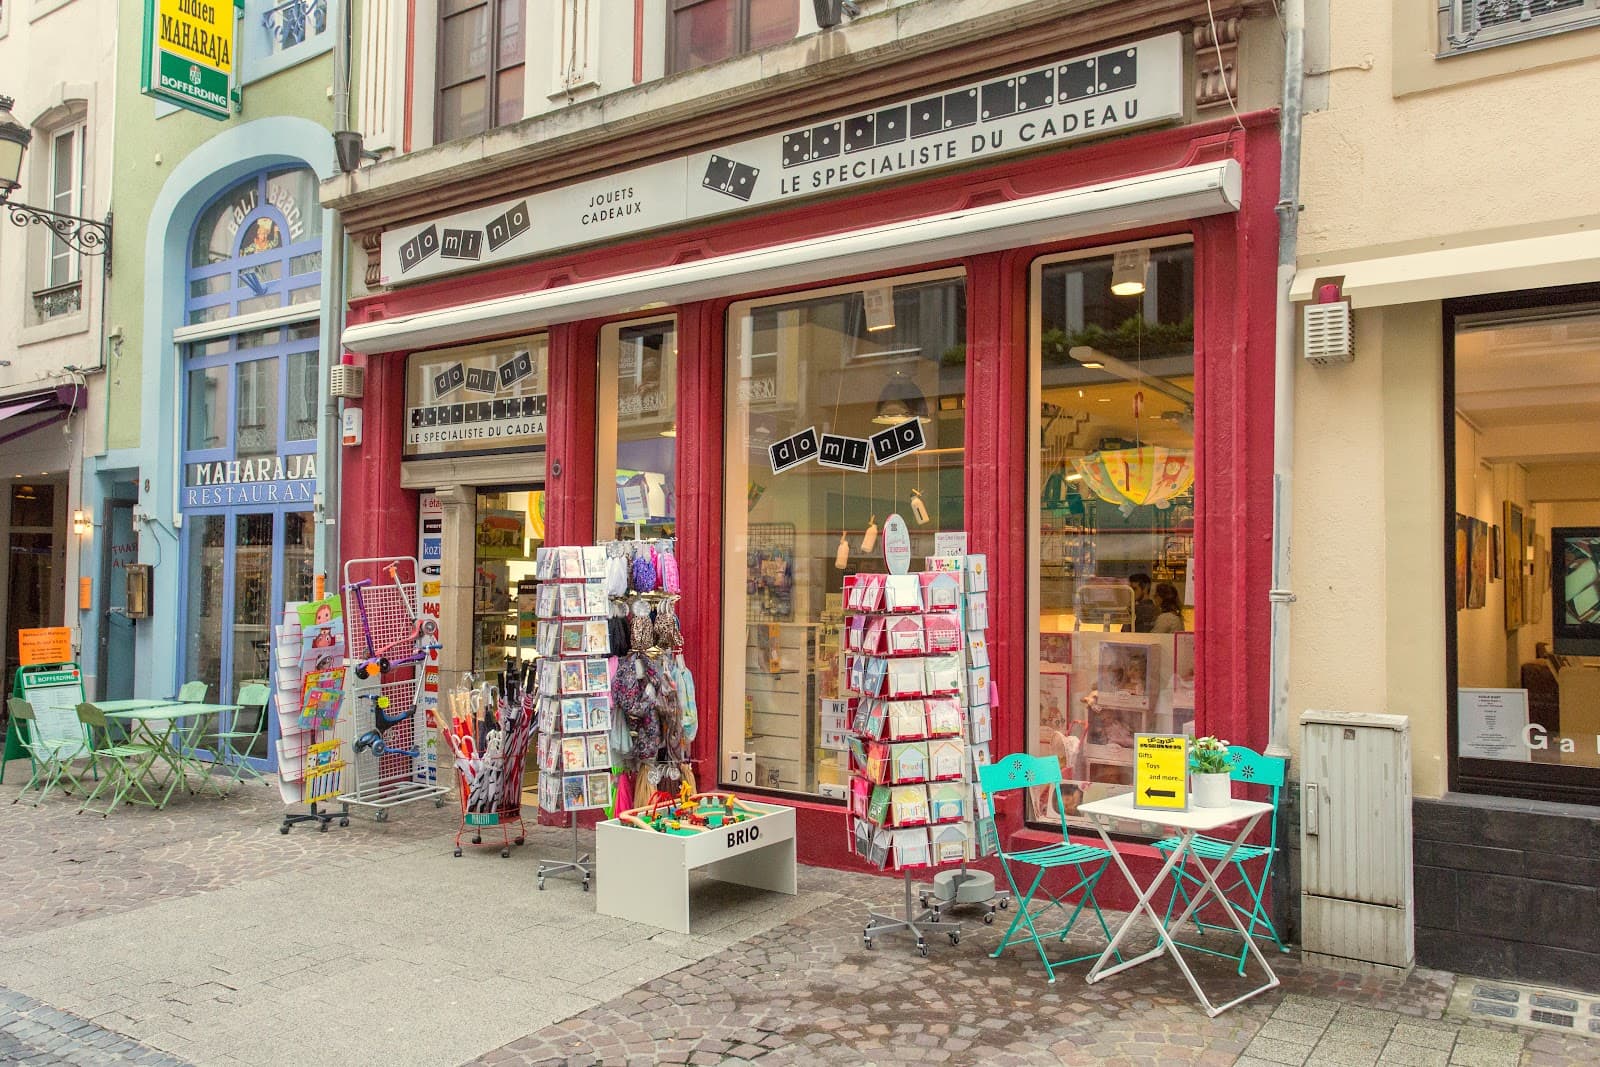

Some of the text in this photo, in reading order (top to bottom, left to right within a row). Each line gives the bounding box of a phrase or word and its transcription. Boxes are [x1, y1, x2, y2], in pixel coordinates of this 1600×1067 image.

[160, 13, 230, 67] MAHARAJA
[161, 75, 227, 107] BOFFERDING
[780, 98, 1139, 195] LE SPECIALISTE DU CADEAU
[580, 201, 642, 226] CADEAUX
[588, 186, 635, 209] JOUETS
[404, 210, 525, 263] domino
[438, 358, 528, 390] domino
[409, 432, 420, 444] LE
[423, 427, 484, 442] SPECIALISTE
[488, 425, 501, 437] DU
[778, 427, 916, 461] domino
[195, 454, 317, 486] MAHARAJA
[727, 825, 760, 849] BRIO
